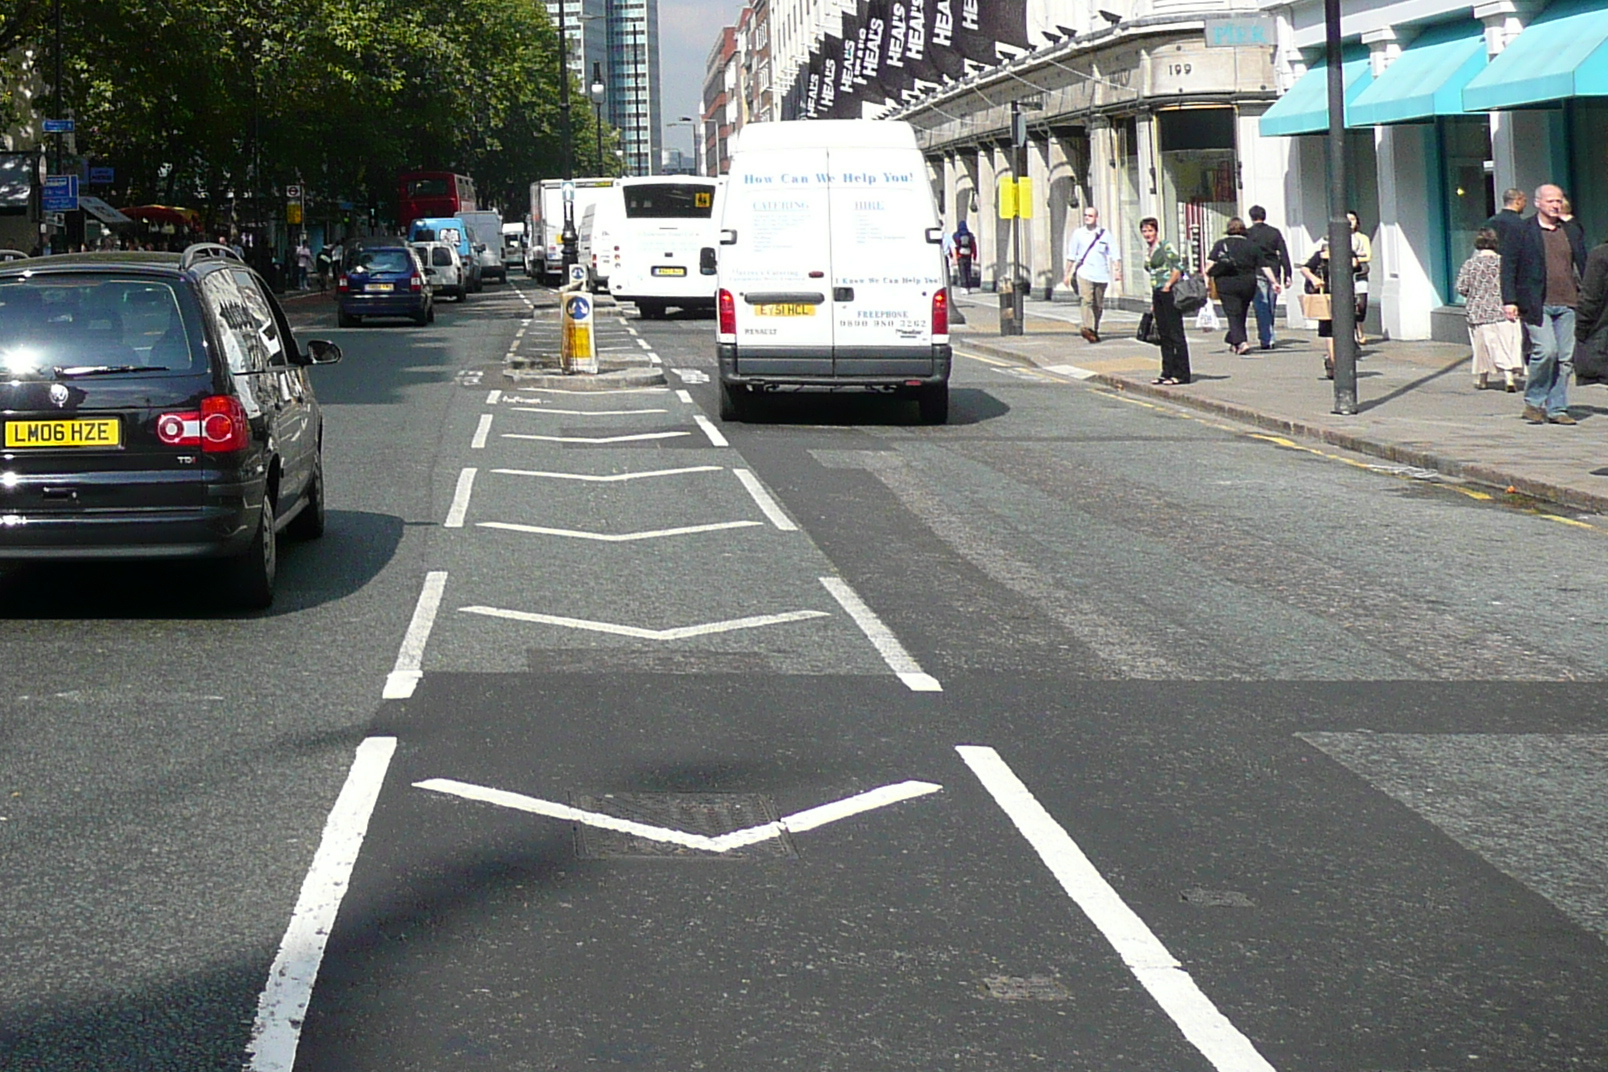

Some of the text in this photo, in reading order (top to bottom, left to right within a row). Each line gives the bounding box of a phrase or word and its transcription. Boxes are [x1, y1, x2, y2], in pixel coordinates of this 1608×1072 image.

[886, 2, 906, 67] HEAL'S
[862, 18, 884, 77] HEAL'S
[1168, 64, 1192, 76] 199
[820, 59, 836, 106] HEAL'S
[744, 171, 914, 185] How Can We Help You!
[752, 201, 810, 210] CATERING
[855, 200, 885, 211] HIRE
[857, 310, 909, 319] FREEPHONE
[13, 422, 110, 443] LM06 HZE
